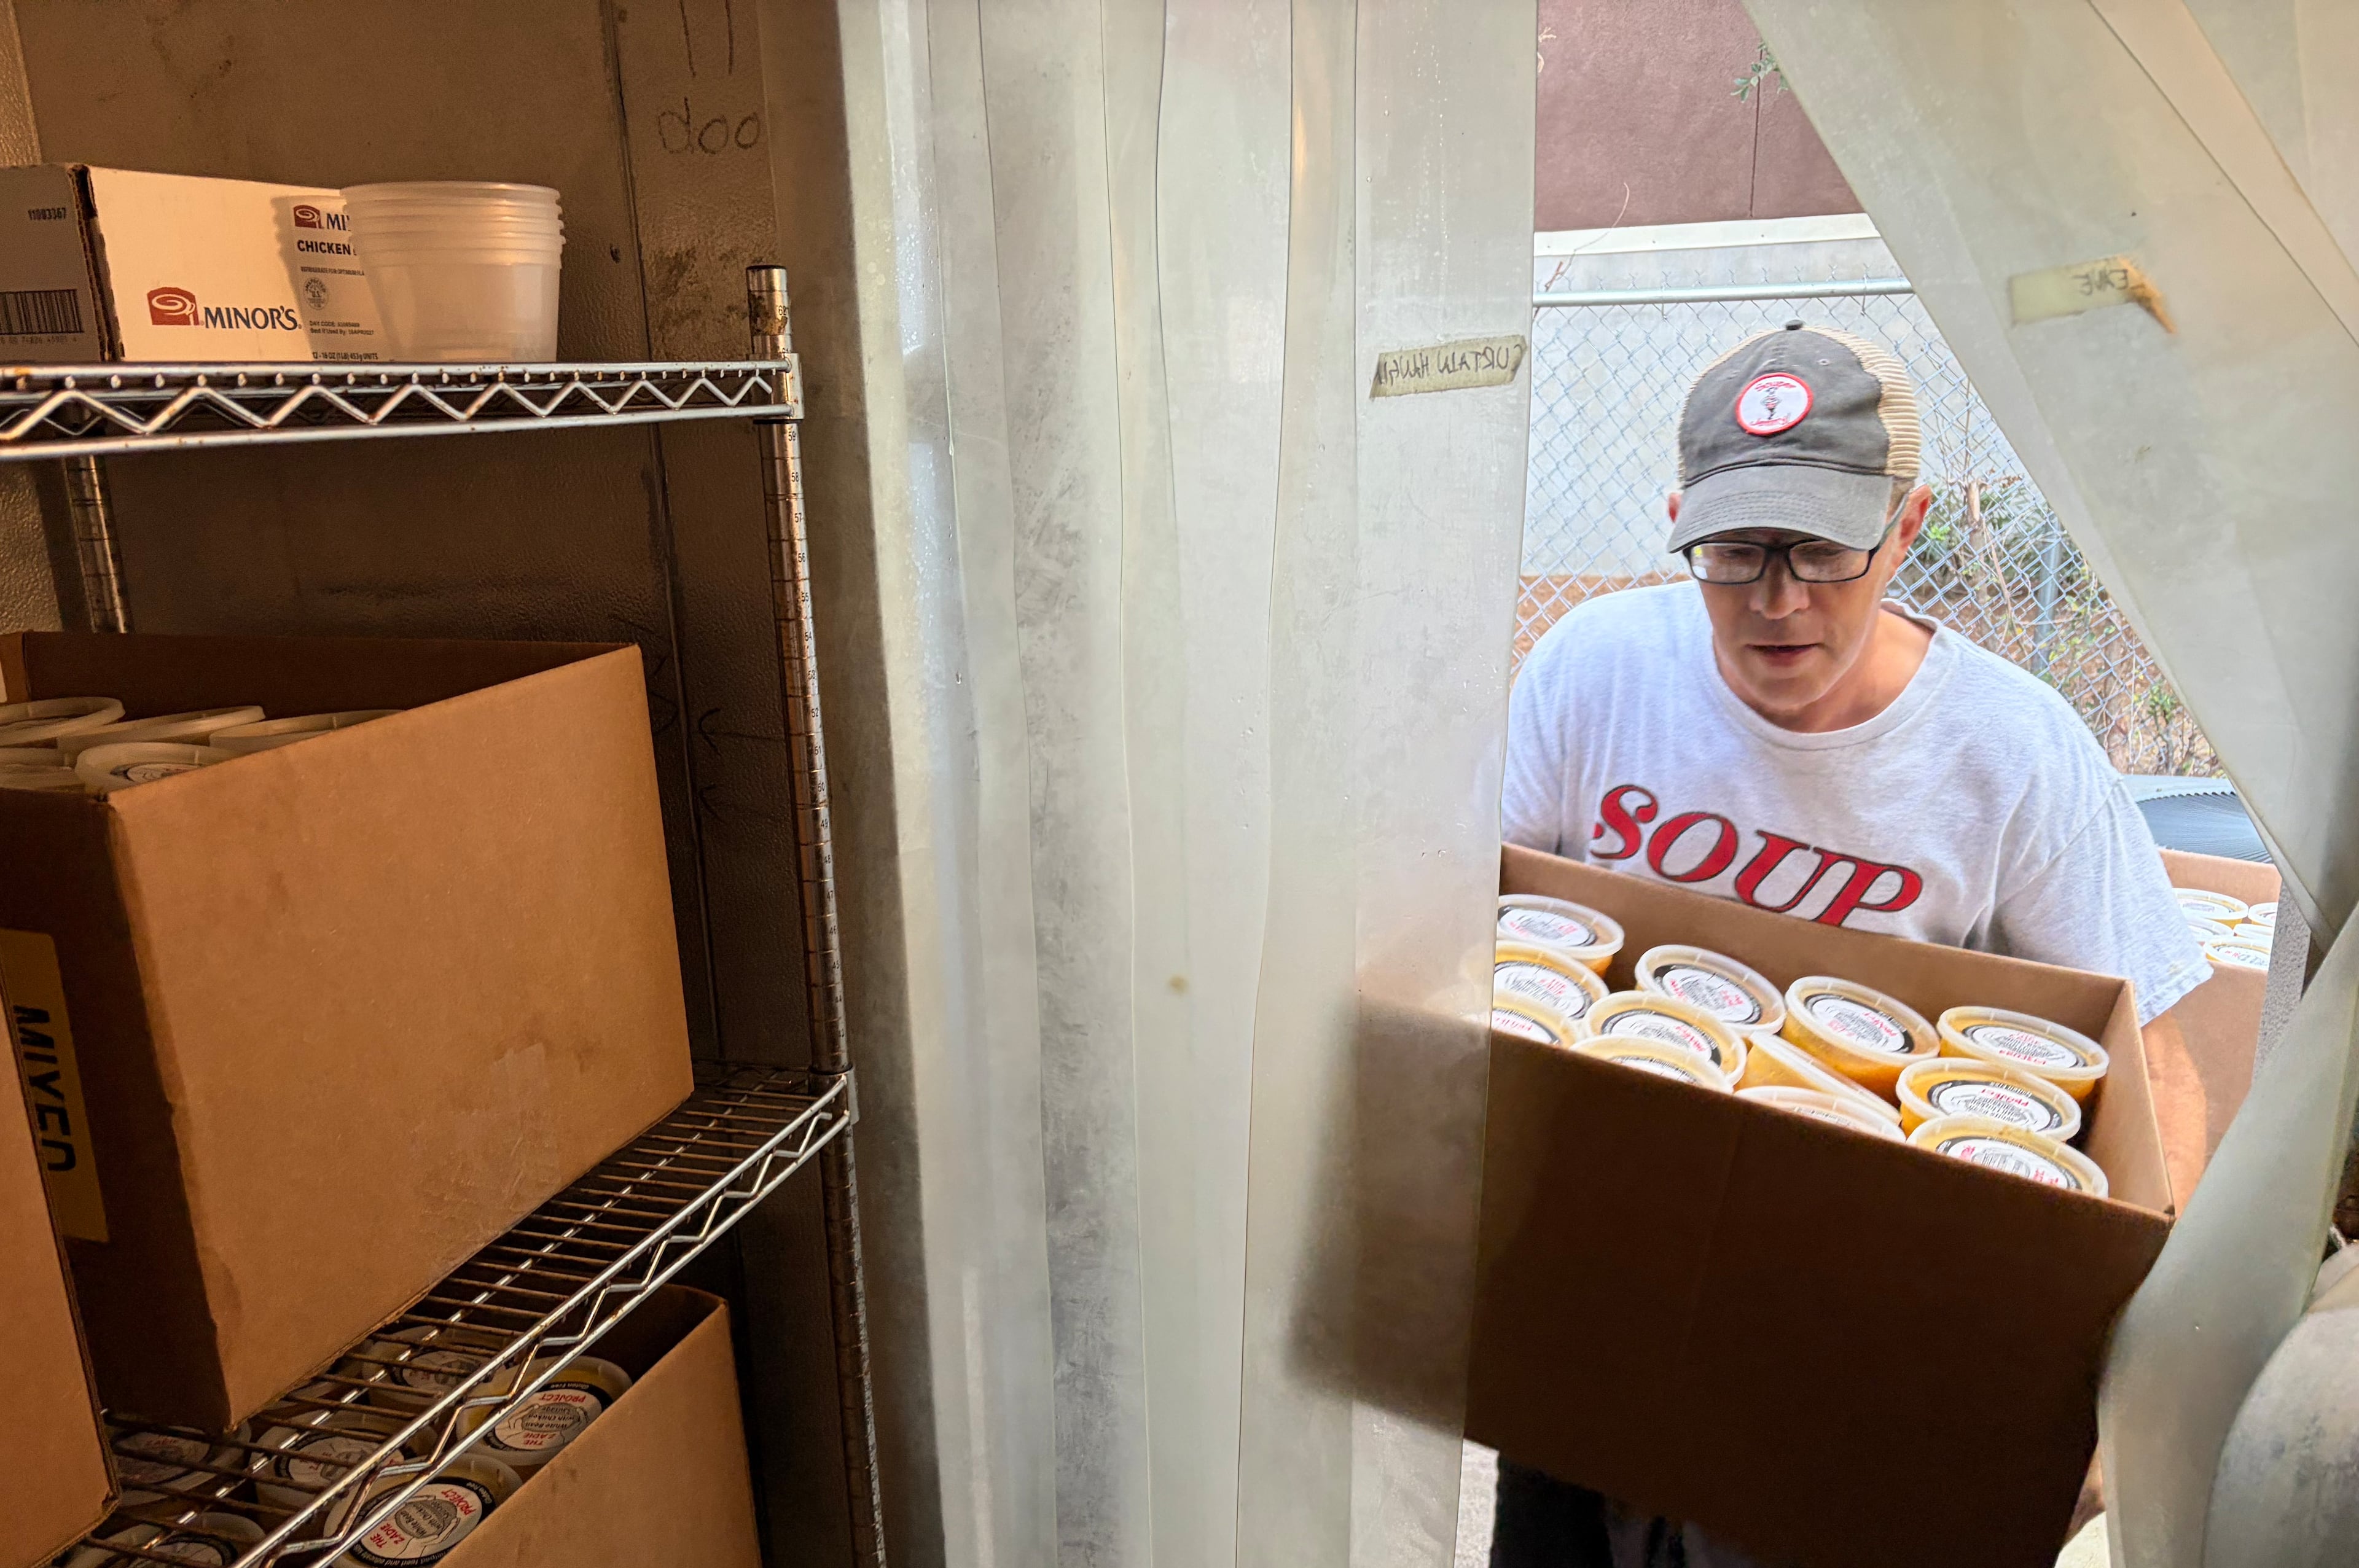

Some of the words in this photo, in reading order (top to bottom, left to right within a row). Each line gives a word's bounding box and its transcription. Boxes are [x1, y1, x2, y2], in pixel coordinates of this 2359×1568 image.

[326, 213, 351, 231] MI
[297, 240, 351, 255] CHICKEN
[778, 305, 788, 316] 62
[204, 305, 298, 330] MINOR'S
[788, 431, 796, 441] 59
[791, 472, 799, 482] 58
[795, 513, 802, 522] 57
[798, 553, 806, 563] 56
[802, 593, 809, 602] 55
[805, 632, 812, 641] 54
[808, 670, 816, 680] 53
[812, 708, 819, 717] 52
[815, 746, 821, 755] 51
[818, 782, 825, 792] 50
[821, 819, 828, 829] 49
[1590, 784, 1922, 928] SOUP
[540, 1392, 587, 1403] PROJECT
[441, 1488, 477, 1516] PROJECT
[400, 1510, 413, 1523] Bean
[380, 1522, 405, 1545] ZADIE
[410, 1521, 427, 1537] White
[369, 1532, 388, 1549] THE
